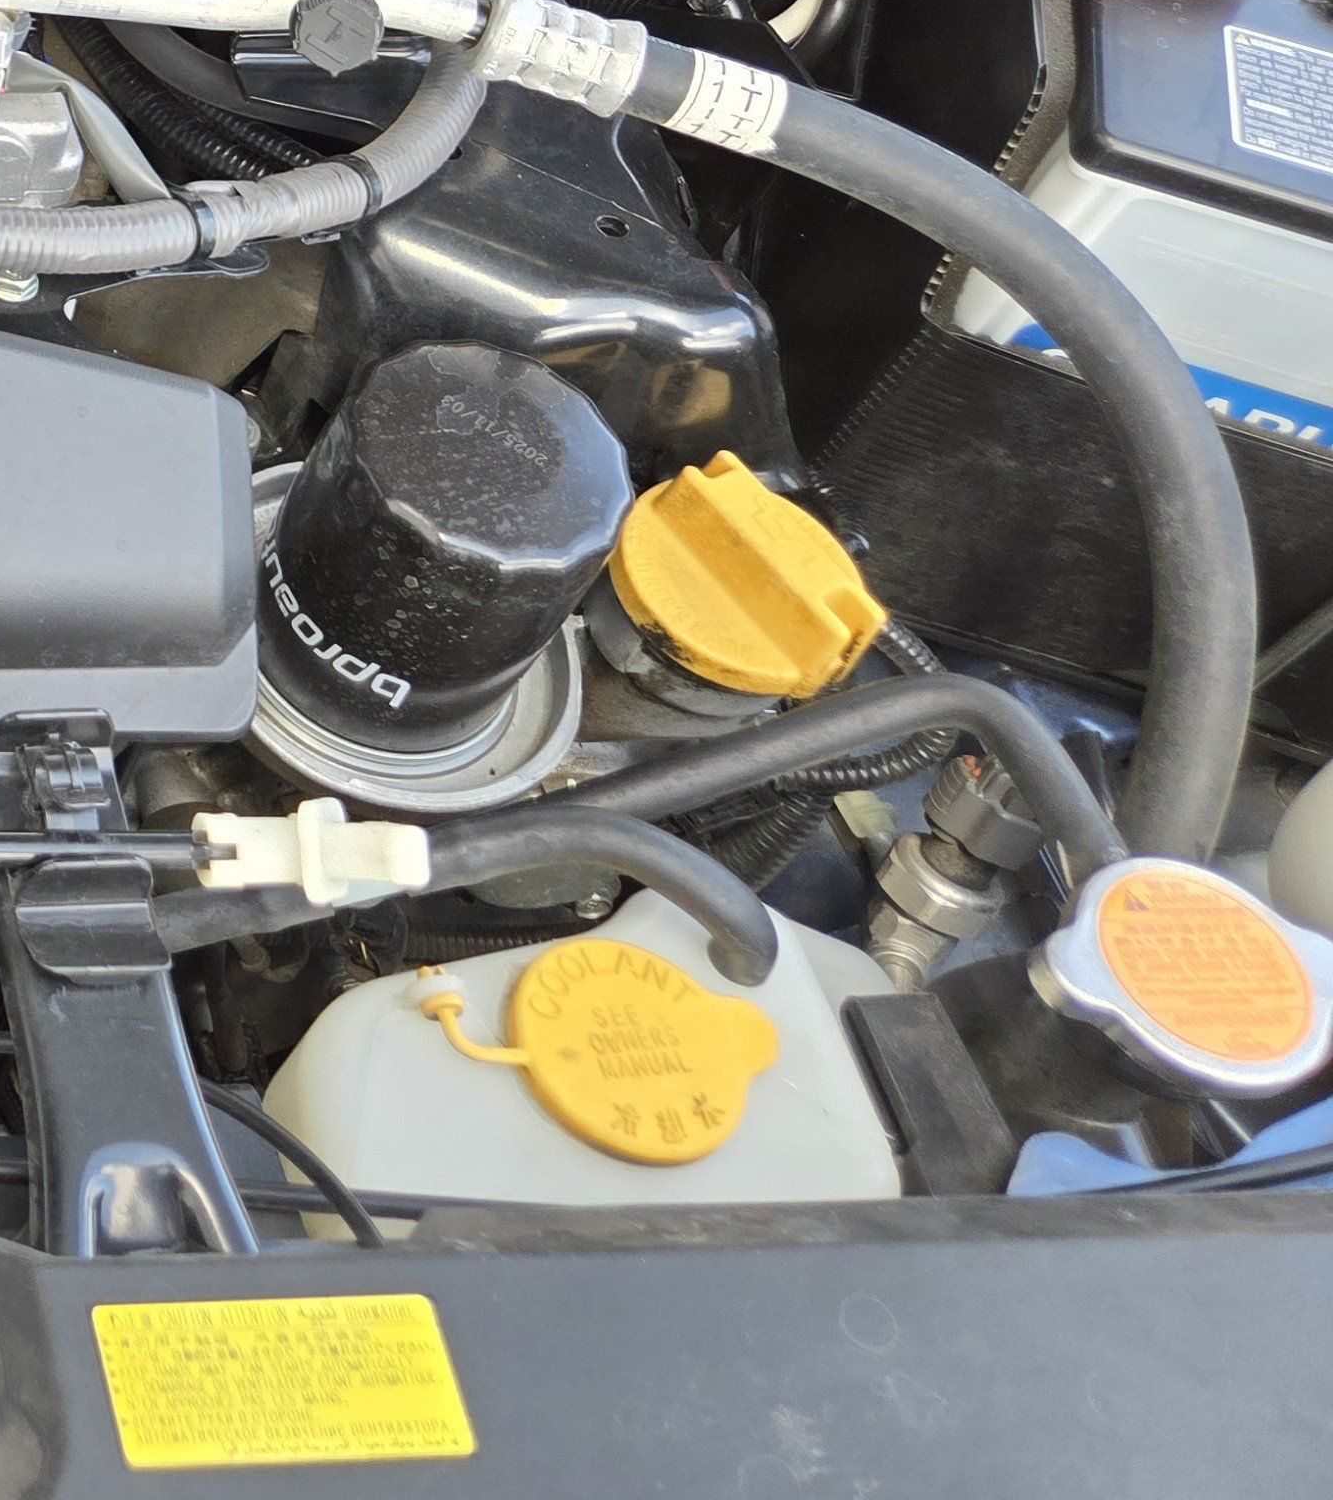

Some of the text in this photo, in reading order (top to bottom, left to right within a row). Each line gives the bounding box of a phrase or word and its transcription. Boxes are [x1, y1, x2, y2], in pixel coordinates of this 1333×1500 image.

[261, 536, 412, 709] bproaut
[527, 947, 700, 1021] COOLANT
[590, 1002, 640, 1029] SEE
[588, 1024, 681, 1056] OWNERS
[595, 1050, 694, 1081] MANUAL
[220, 1303, 290, 1327] ATTENTION
